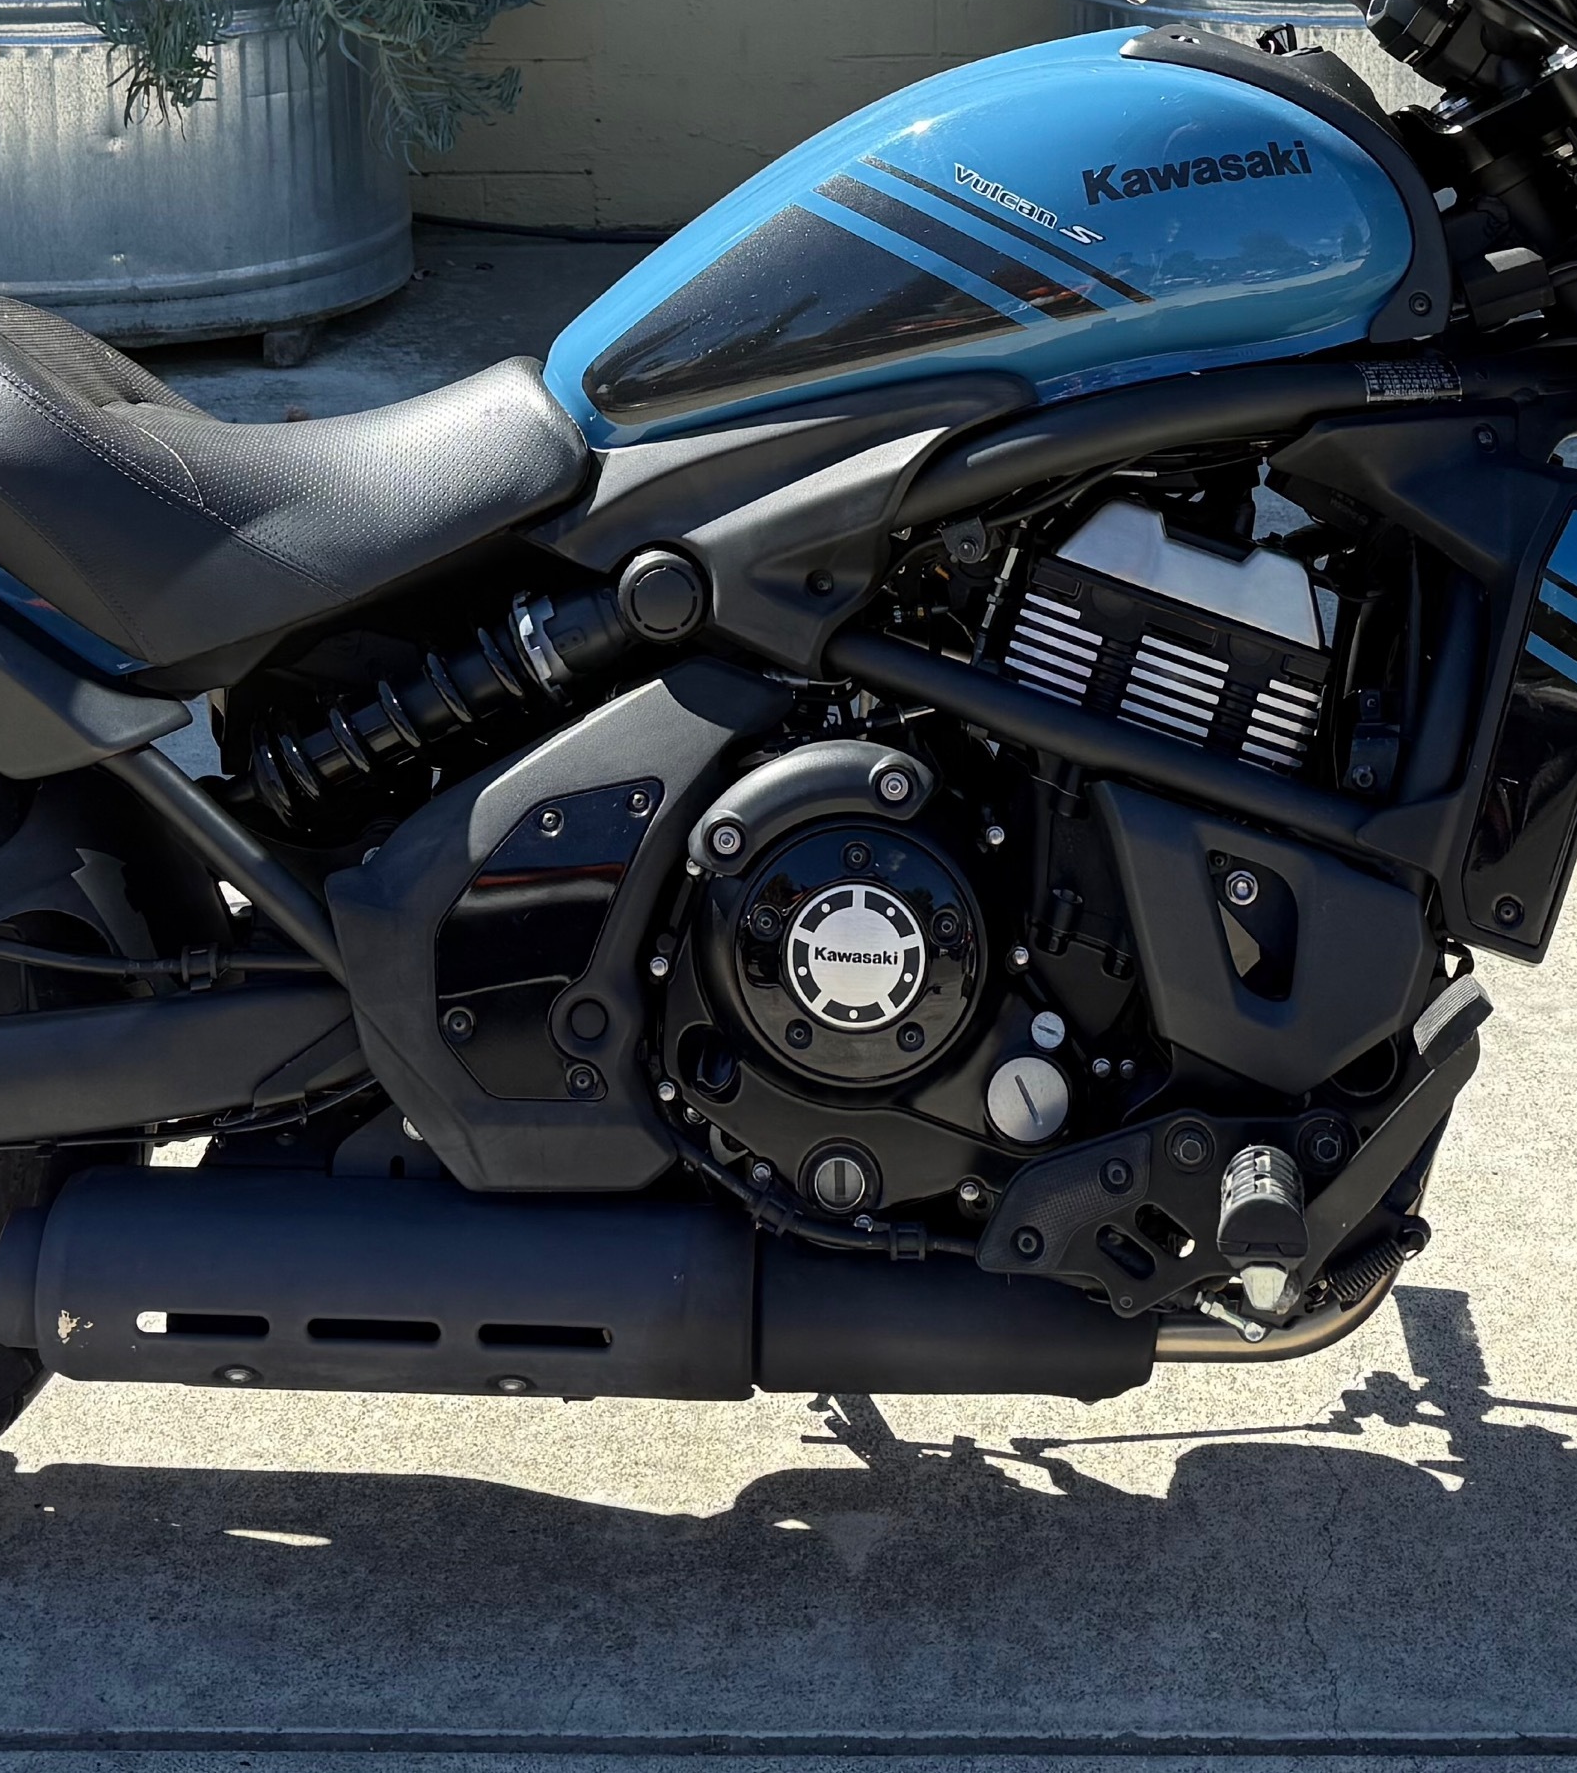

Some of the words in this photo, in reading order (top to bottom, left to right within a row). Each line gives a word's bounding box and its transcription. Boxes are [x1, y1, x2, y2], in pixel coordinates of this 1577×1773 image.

[953, 161, 1060, 230] Vulcan
[1059, 223, 1107, 245] S
[1082, 139, 1313, 206] Kawasaki
[814, 946, 899, 966] Kawasaki
